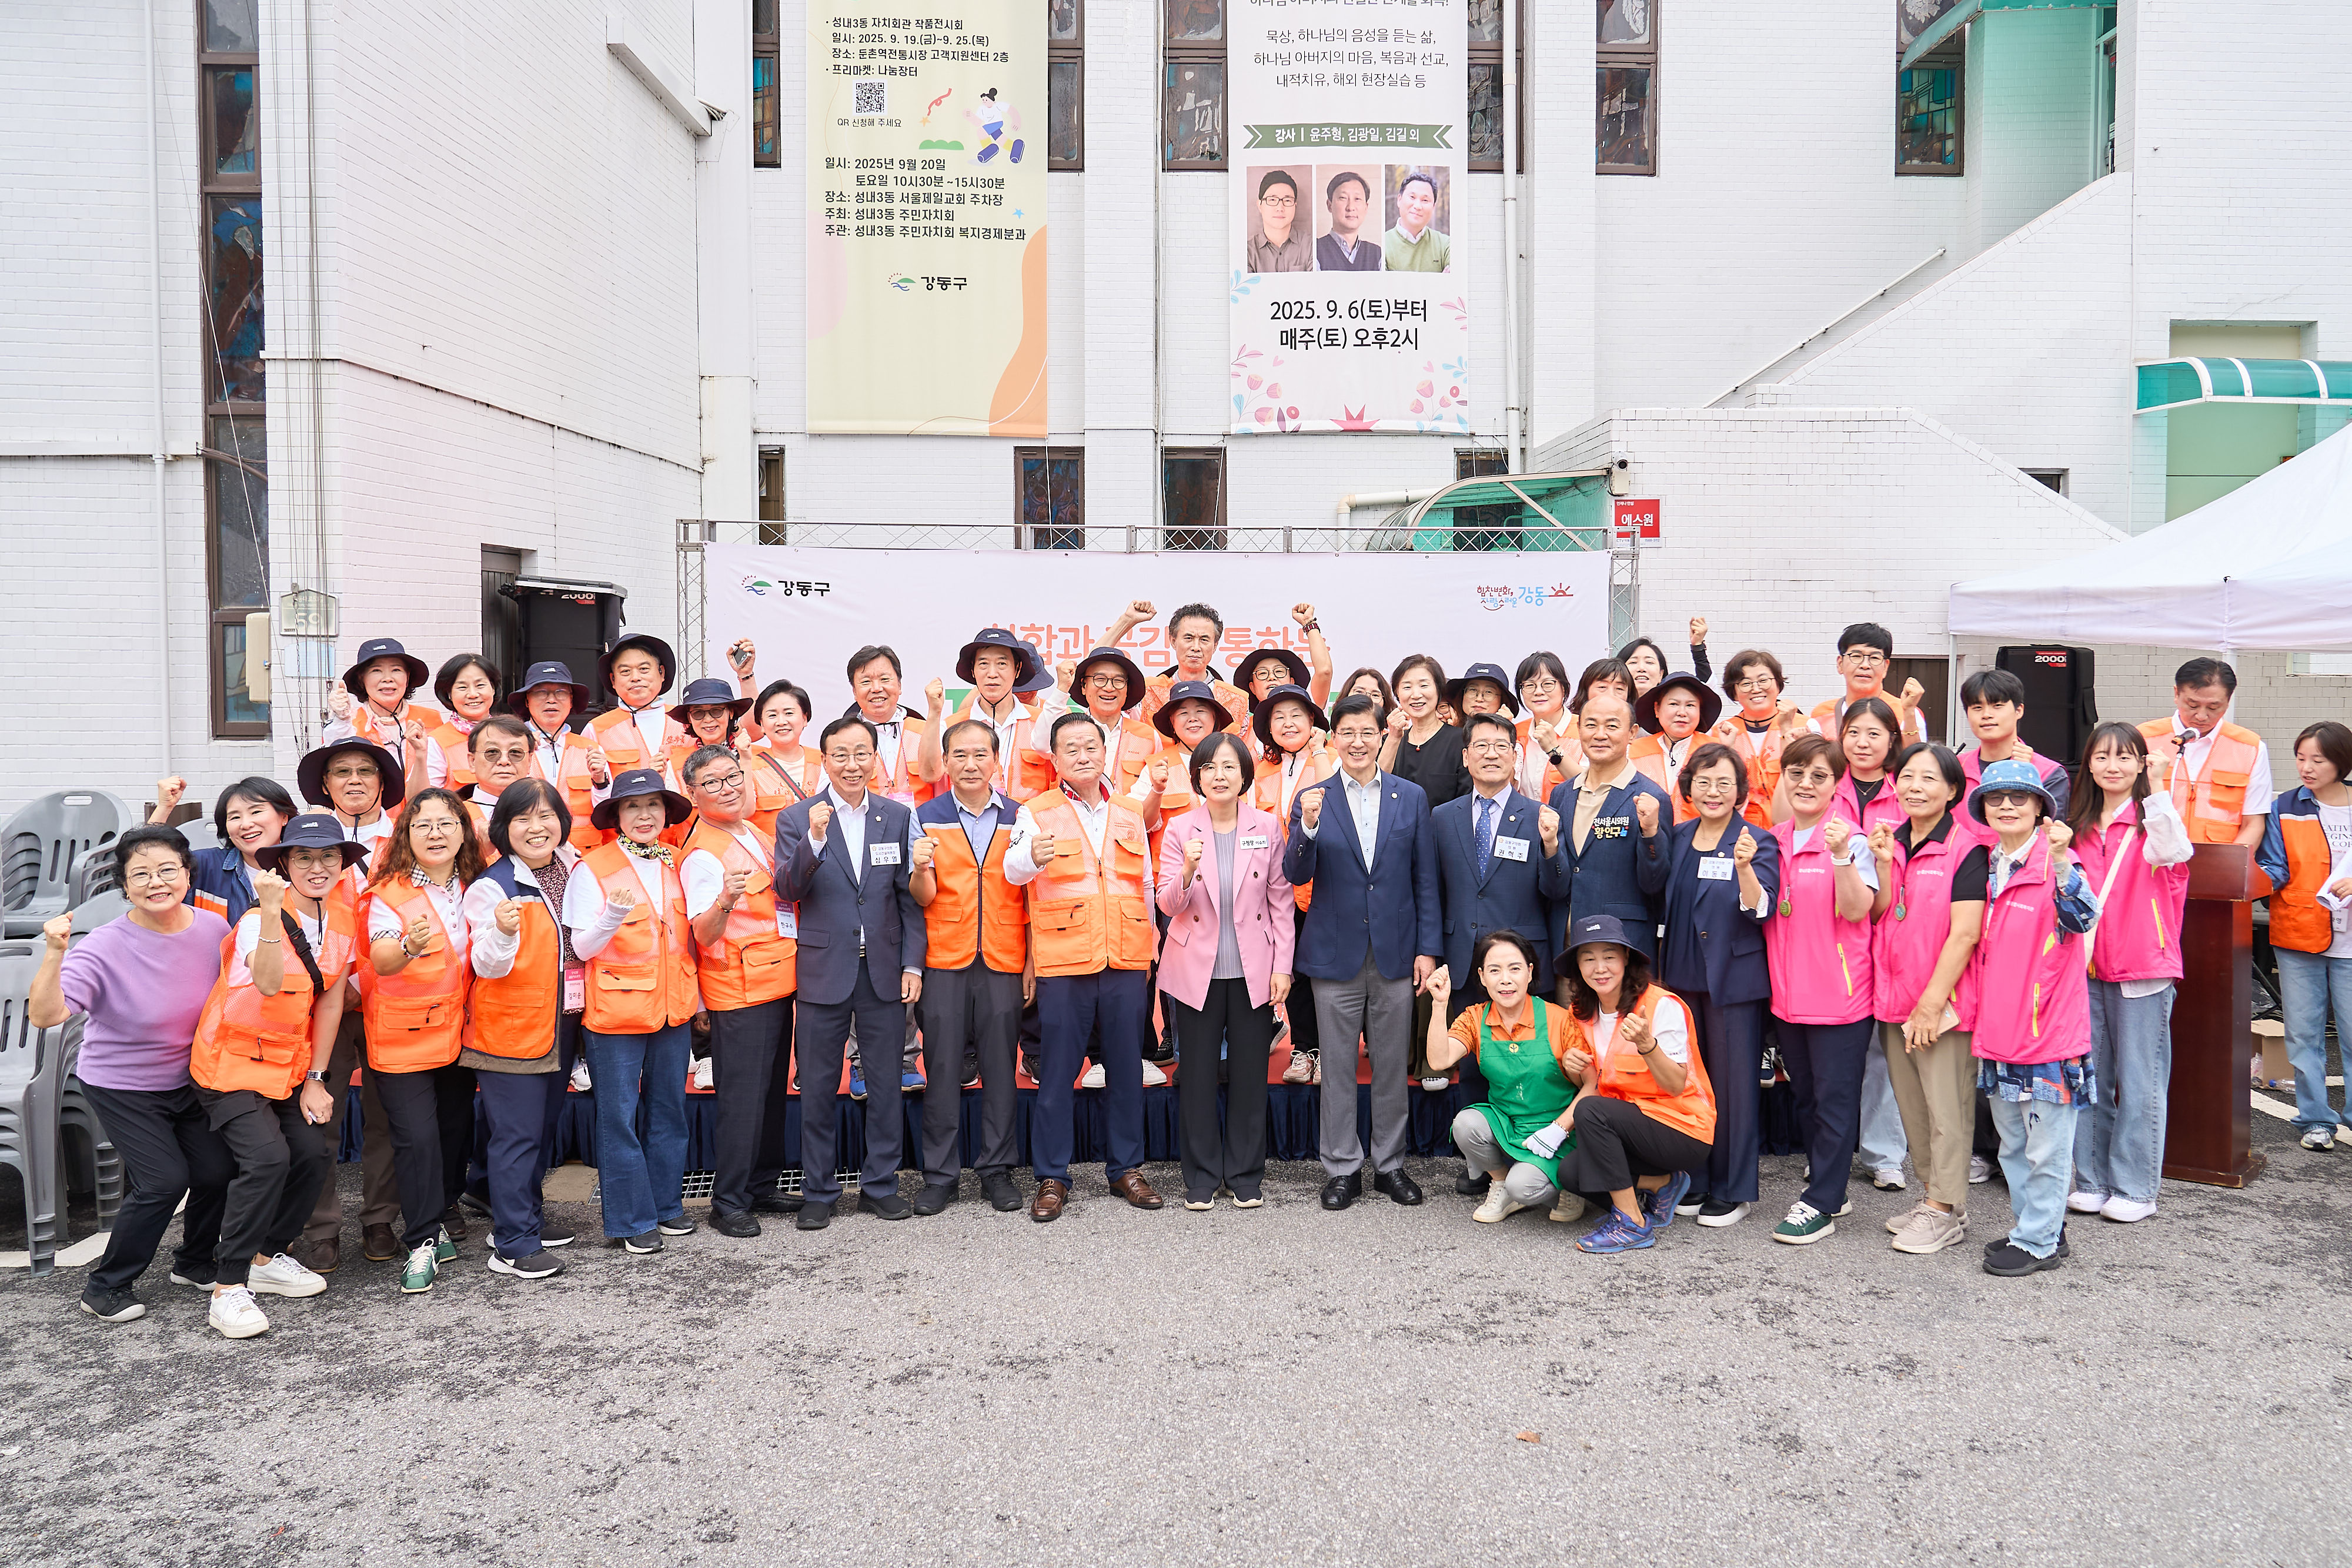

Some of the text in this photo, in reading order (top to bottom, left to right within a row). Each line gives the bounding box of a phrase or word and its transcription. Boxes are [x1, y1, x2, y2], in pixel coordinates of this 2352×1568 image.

[833, 17, 962, 30] 성내3동 자치회관 작품전시회
[833, 33, 988, 46] 일시: 2025. 9. 19.(금)~9. 25.(목)
[1267, 28, 1435, 44] 묵상, 하나님의 음성을 듣는 삶,
[833, 48, 1008, 62] 장소: 둔촌역전통시장 고객지원센터 2층
[1254, 51, 1448, 66] 하나님 아버지의 마음, 복음과 선교,
[833, 65, 917, 76] 프리마켓: 나눔장터
[1277, 73, 1426, 88] 내적치유, 해외 현장실습 등
[853, 118, 874, 127] 신청해
[878, 119, 901, 127] 주세요
[1275, 128, 1295, 142] 강사
[1309, 128, 1344, 142] 윤주형,
[1348, 128, 1382, 142] 김광일,
[1386, 128, 1406, 142] 김길
[1409, 129, 1419, 142] 외
[826, 158, 945, 170] 일시: 2025년 9월 20일
[856, 175, 1004, 189] 토요일 10시30분 ~15시30분
[826, 191, 1003, 206] 장소: 성내3동 서울제일교회 주차장
[826, 208, 954, 221] 주최: 성내3동 주민자치회
[826, 225, 1025, 240] 주관: 성내3동 주민자치회 복지경제분과
[921, 277, 967, 290] 강동구
[1271, 299, 1426, 322] 2025. 9. 6(토)부터
[1281, 327, 1417, 352] 매주(토) 오후2시
[1622, 514, 1653, 526] 에스원
[779, 581, 830, 596] 강동구
[1477, 586, 1514, 597] 힘찬변화,
[1518, 587, 1549, 606] 강동
